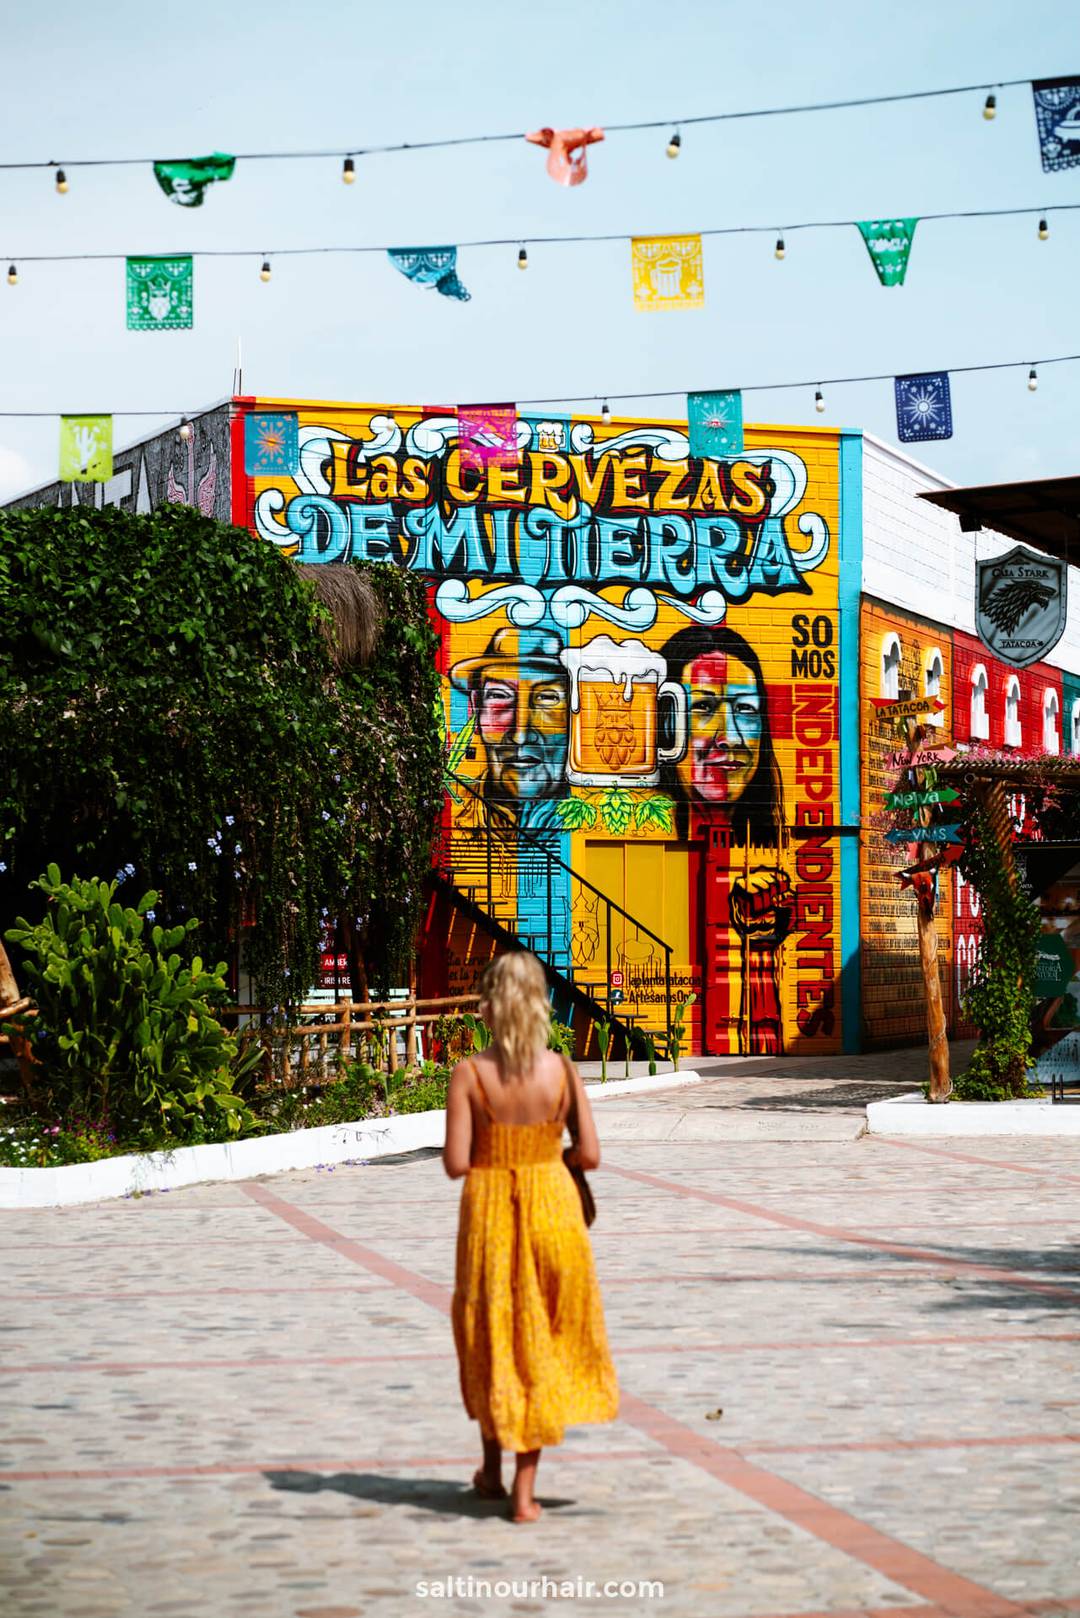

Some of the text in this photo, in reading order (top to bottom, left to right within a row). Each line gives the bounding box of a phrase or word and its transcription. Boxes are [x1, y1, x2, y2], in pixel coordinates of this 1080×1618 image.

[329, 440, 769, 520] Las CERVEZAS
[287, 495, 802, 598] DE MI TIERRA
[791, 614, 833, 648] SO
[1001, 640, 1036, 648] TATACOA
[791, 649, 835, 678] MOS
[876, 700, 930, 718] LA TATACOA
[916, 750, 943, 764] YORK
[795, 684, 835, 1036] INDEPENDIENTES
[627, 971, 701, 988] laplantaatacoa
